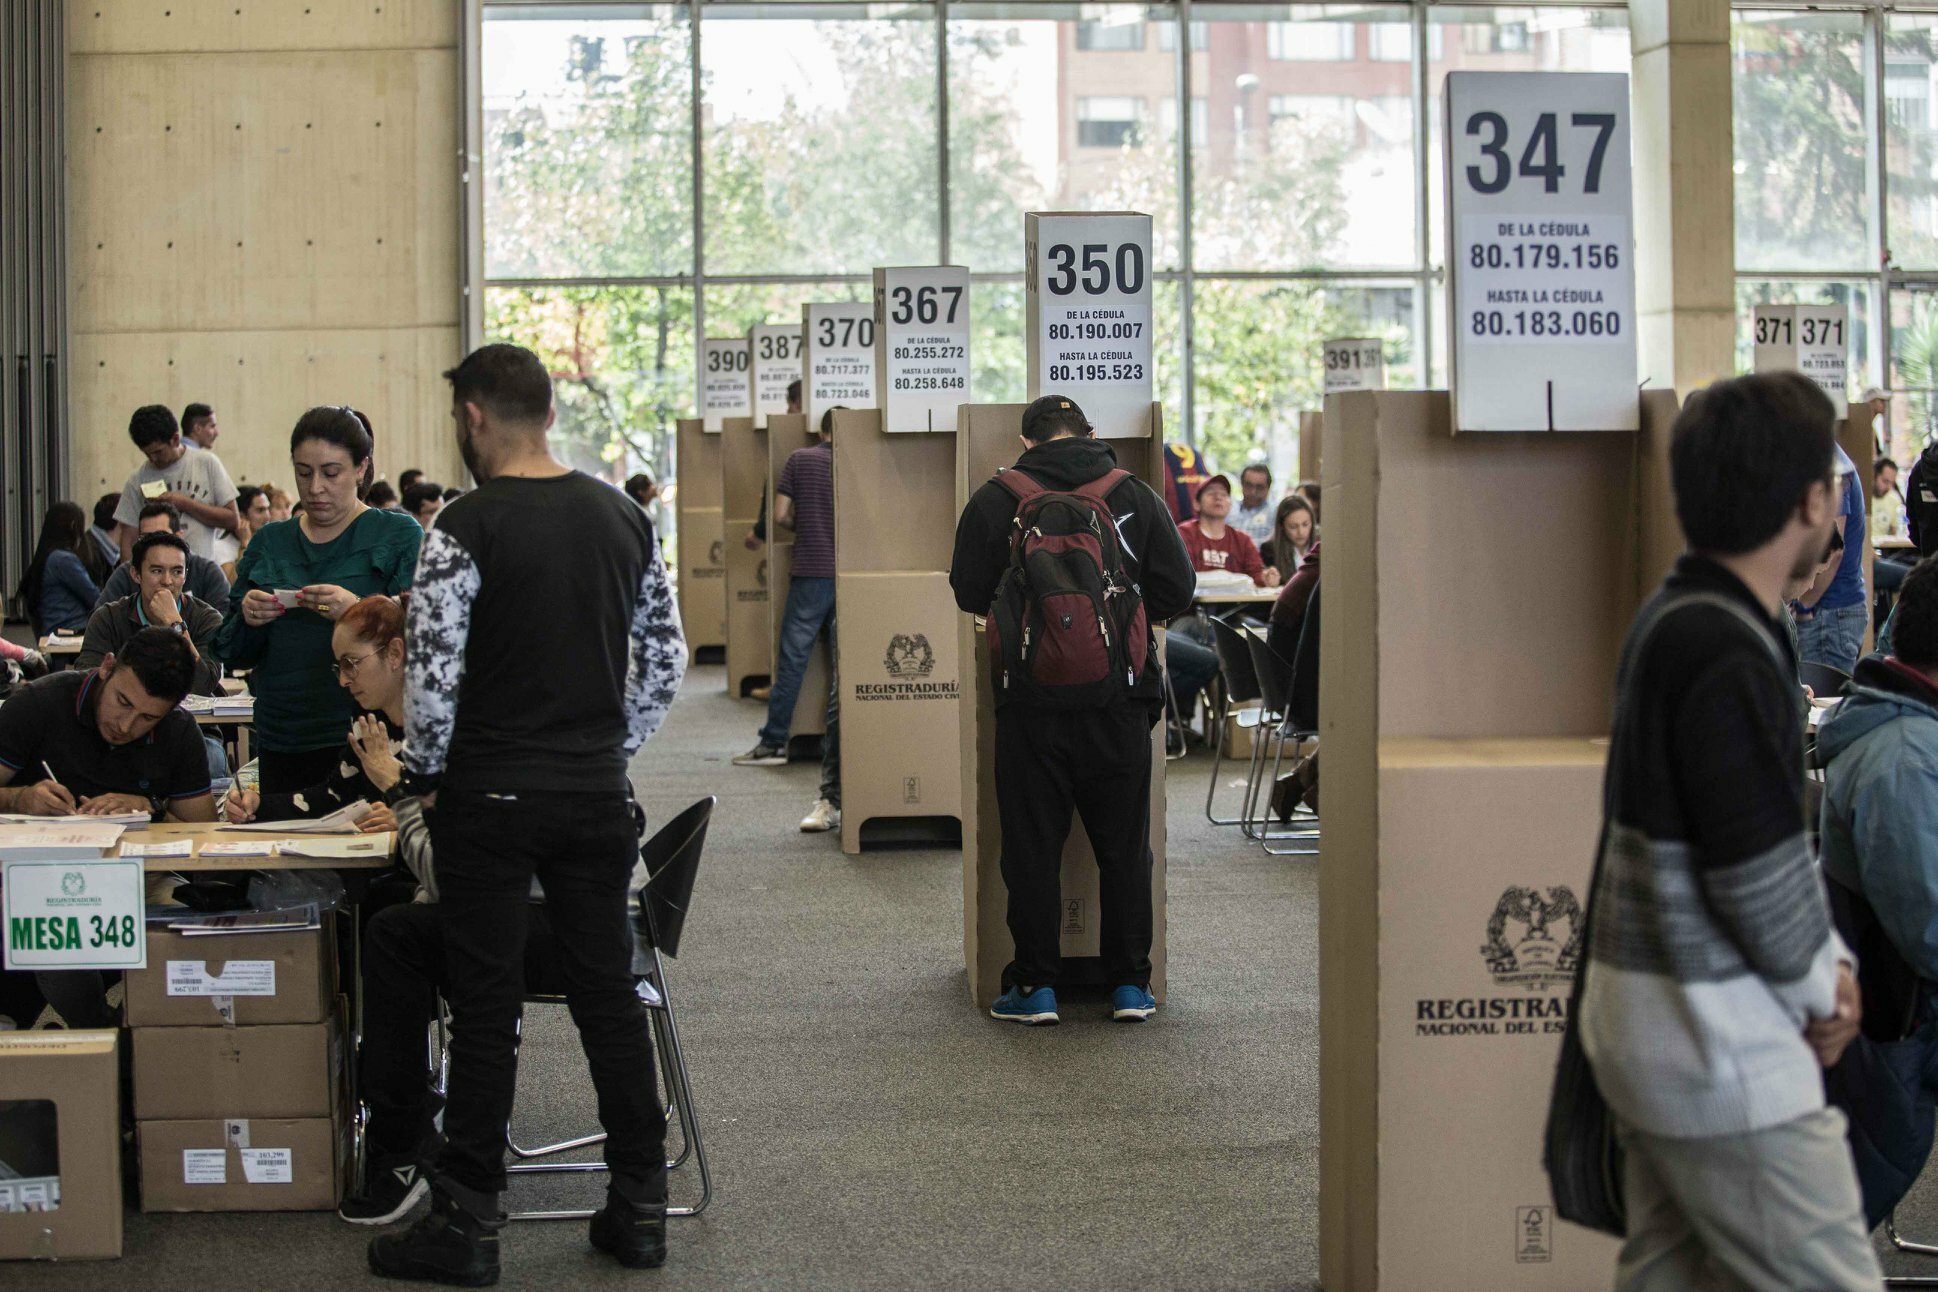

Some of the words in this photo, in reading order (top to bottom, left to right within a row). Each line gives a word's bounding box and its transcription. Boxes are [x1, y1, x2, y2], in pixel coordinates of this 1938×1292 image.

[1465, 111, 1616, 195] 347
[1498, 222, 1515, 236] DE
[1519, 222, 1535, 236] LA
[1539, 220, 1590, 237] CÉDULA
[1470, 244, 1619, 269] 80.179.156
[1047, 242, 1144, 296] 350
[891, 286, 963, 325] 367
[1487, 290, 1528, 304] HASTA
[1533, 290, 1549, 304] LA
[1553, 287, 1604, 304] CÉDULA
[1066, 310, 1078, 320] DE
[1080, 310, 1090, 319] LA
[1092, 308, 1125, 319] CÉDULA
[1472, 311, 1621, 336] 80.183.060
[819, 318, 874, 348] 370
[926, 336, 950, 344] CÉDULA
[1049, 322, 1143, 340] 80.190.007
[1756, 317, 1791, 345] 371
[1802, 318, 1843, 346] 371
[760, 335, 802, 360] 387
[894, 346, 964, 359] 80.255.272
[1059, 352, 1086, 361] HASTA
[1088, 352, 1098, 361] LA
[1100, 350, 1133, 361] CÉDULA
[708, 350, 749, 372] 390
[815, 365, 870, 375] 80.717.377
[1327, 348, 1360, 370] 391
[932, 367, 957, 375] CÉDULA
[1049, 364, 1143, 381] 80.195.523
[895, 377, 964, 390] 80.258.648
[1170, 443, 1195, 469] 9
[11, 916, 82, 950] MESA
[90, 915, 136, 948] 348
[1416, 1022, 1500, 1036] NACIONAL
[1505, 1021, 1538, 1035] DEL
[1543, 1021, 1568, 1034] ES
